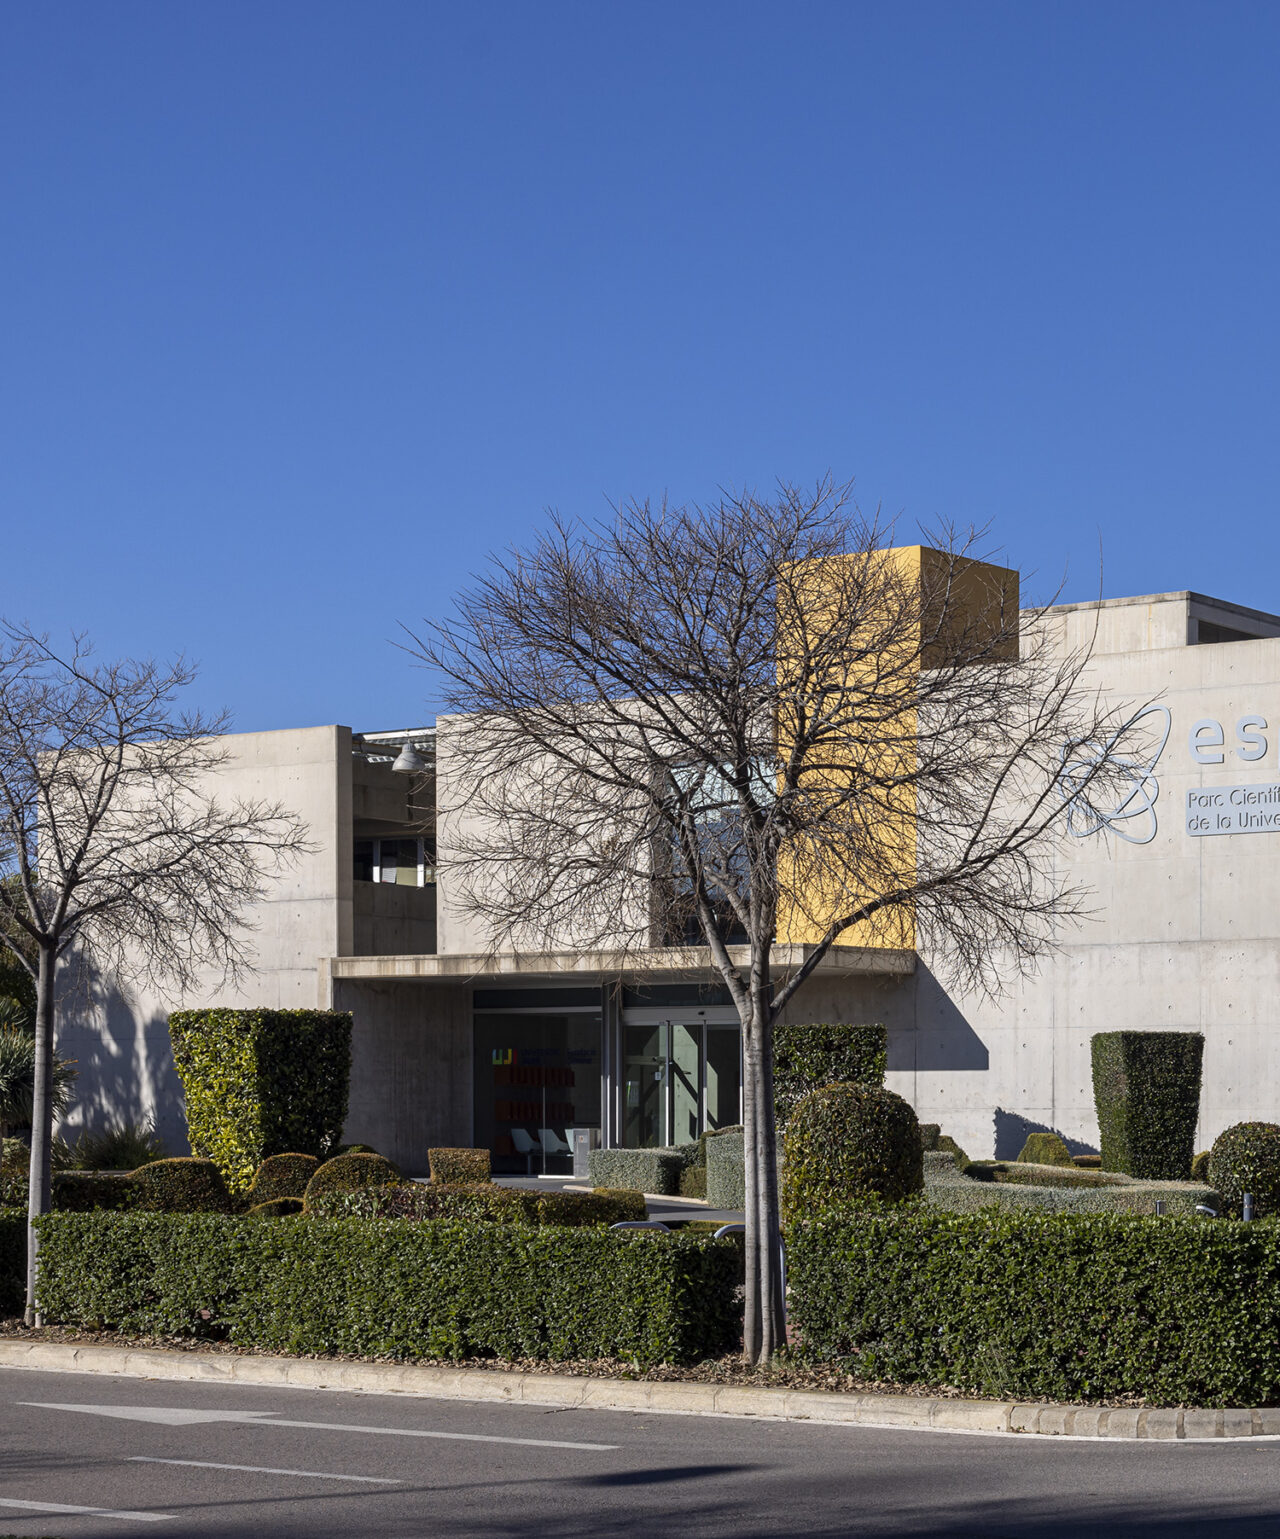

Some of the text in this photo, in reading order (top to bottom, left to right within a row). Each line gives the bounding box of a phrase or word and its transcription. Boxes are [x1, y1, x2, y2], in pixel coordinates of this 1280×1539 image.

[1188, 792, 1225, 809] Parc
[1188, 814, 1210, 831] de
[1216, 813, 1231, 830] la
